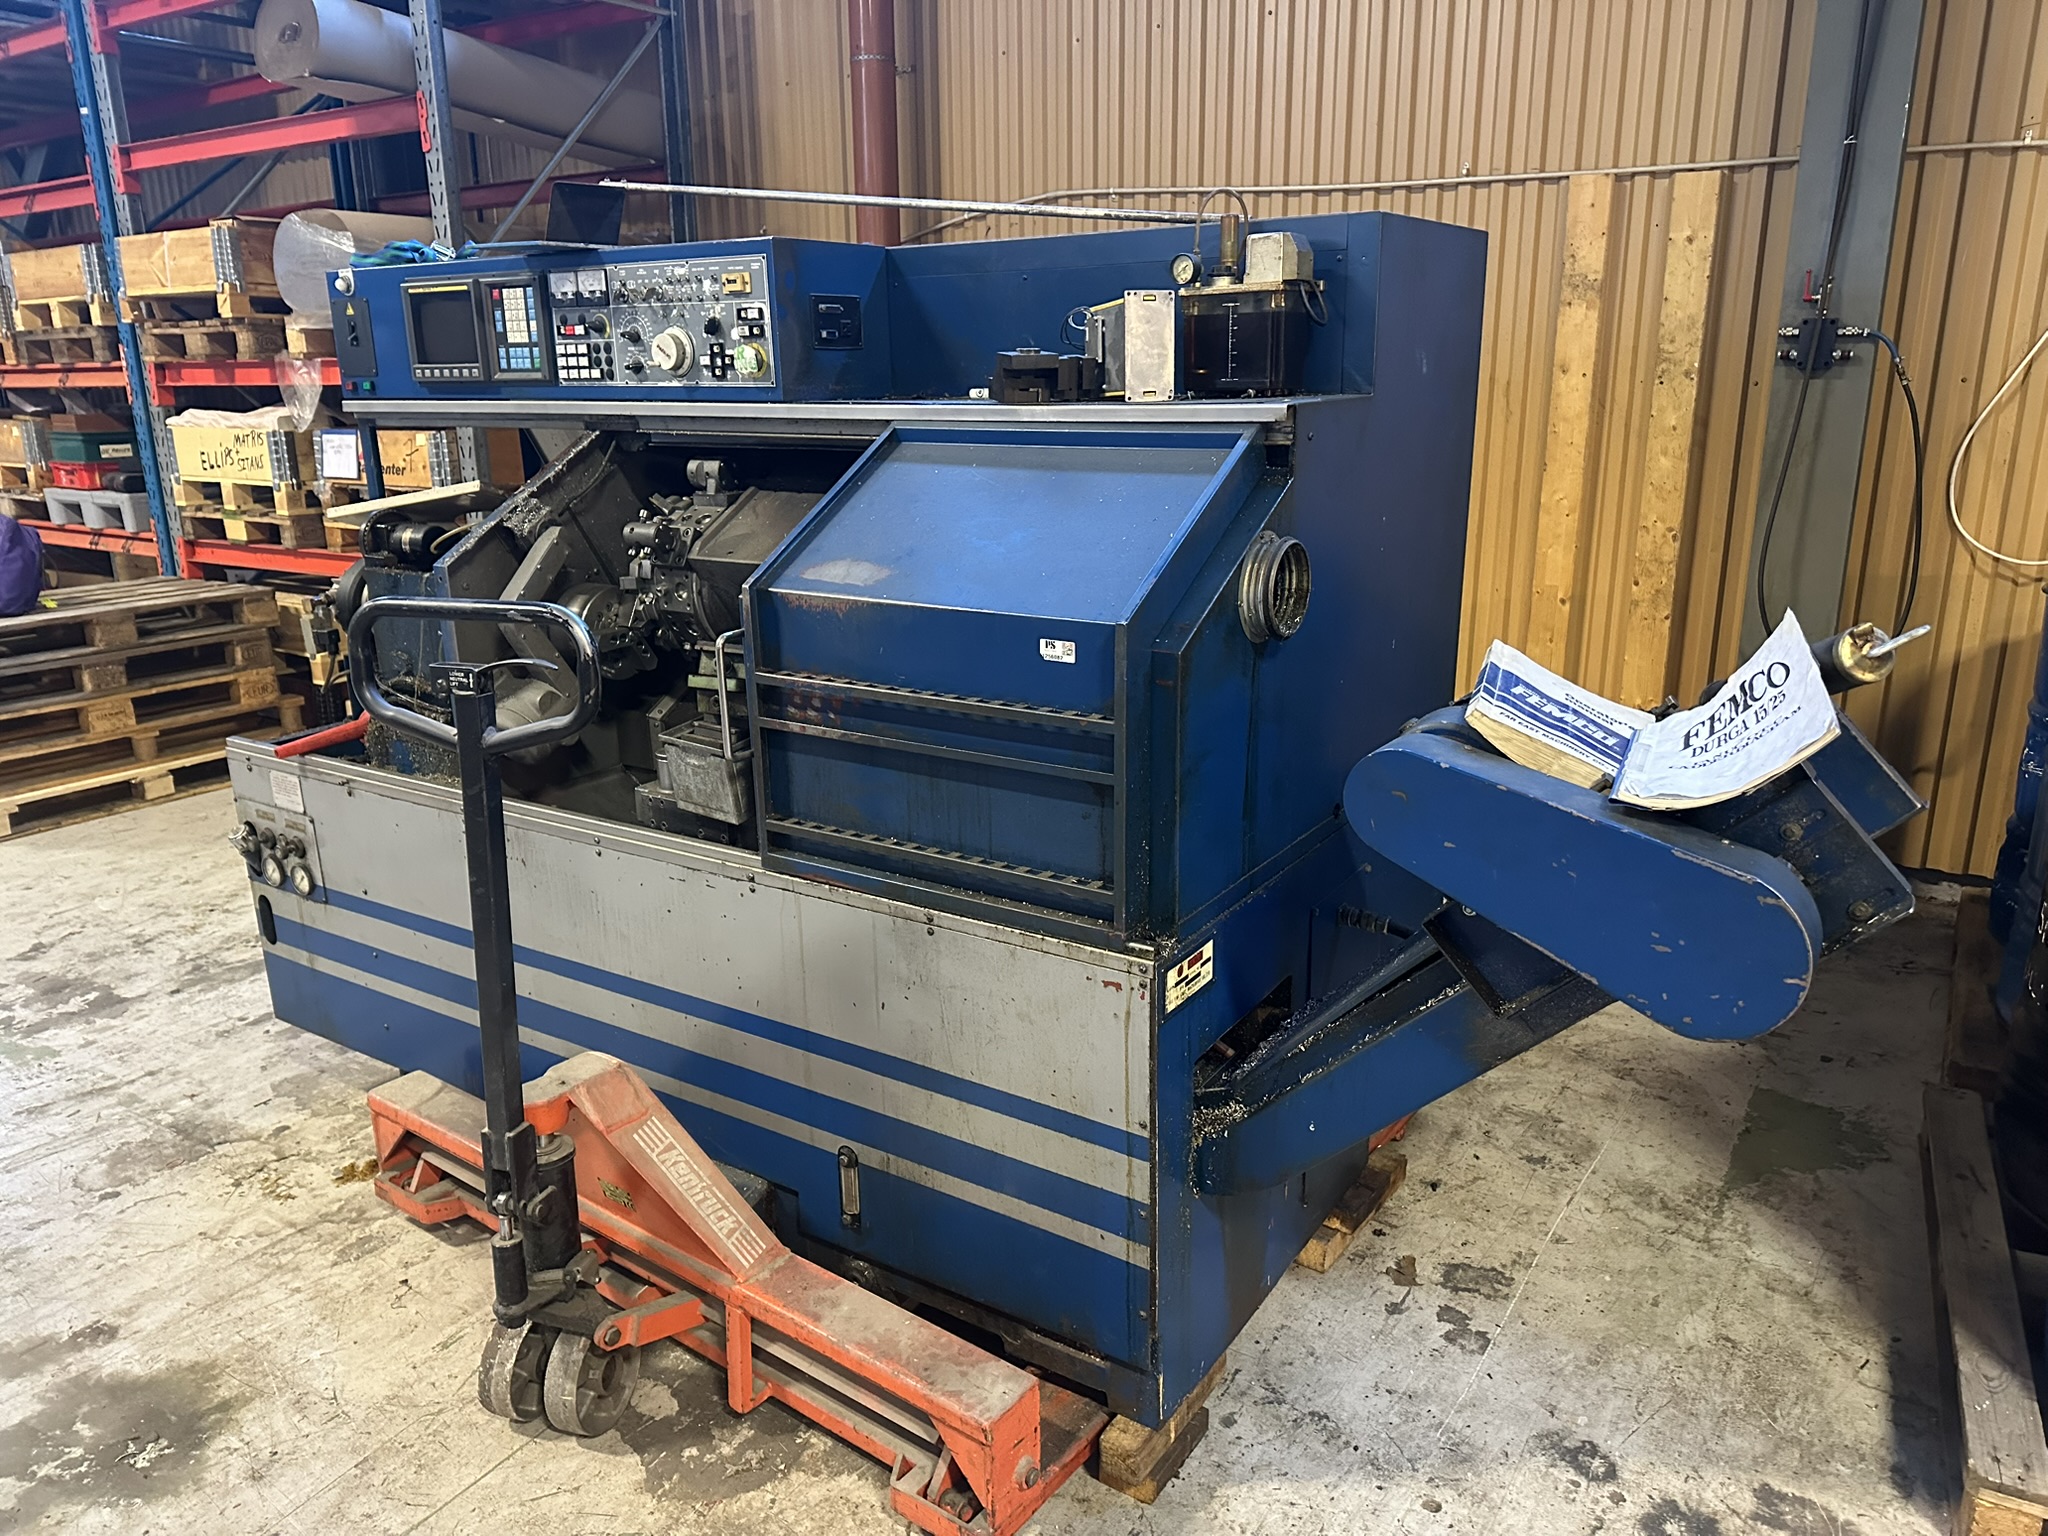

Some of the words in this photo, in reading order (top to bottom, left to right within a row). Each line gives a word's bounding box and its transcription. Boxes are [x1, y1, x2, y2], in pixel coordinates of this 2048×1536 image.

[233, 430, 264, 448] MATRIS
[1499, 711, 1517, 722] FAR
[1518, 721, 1541, 735] EAST
[1541, 732, 1590, 759] MACHINERY
[1510, 685, 1620, 747] FEMCO
[1680, 662, 1790, 752] FEMCO
[1690, 719, 1750, 759] DURGA
[1753, 689, 1786, 725] 15/25
